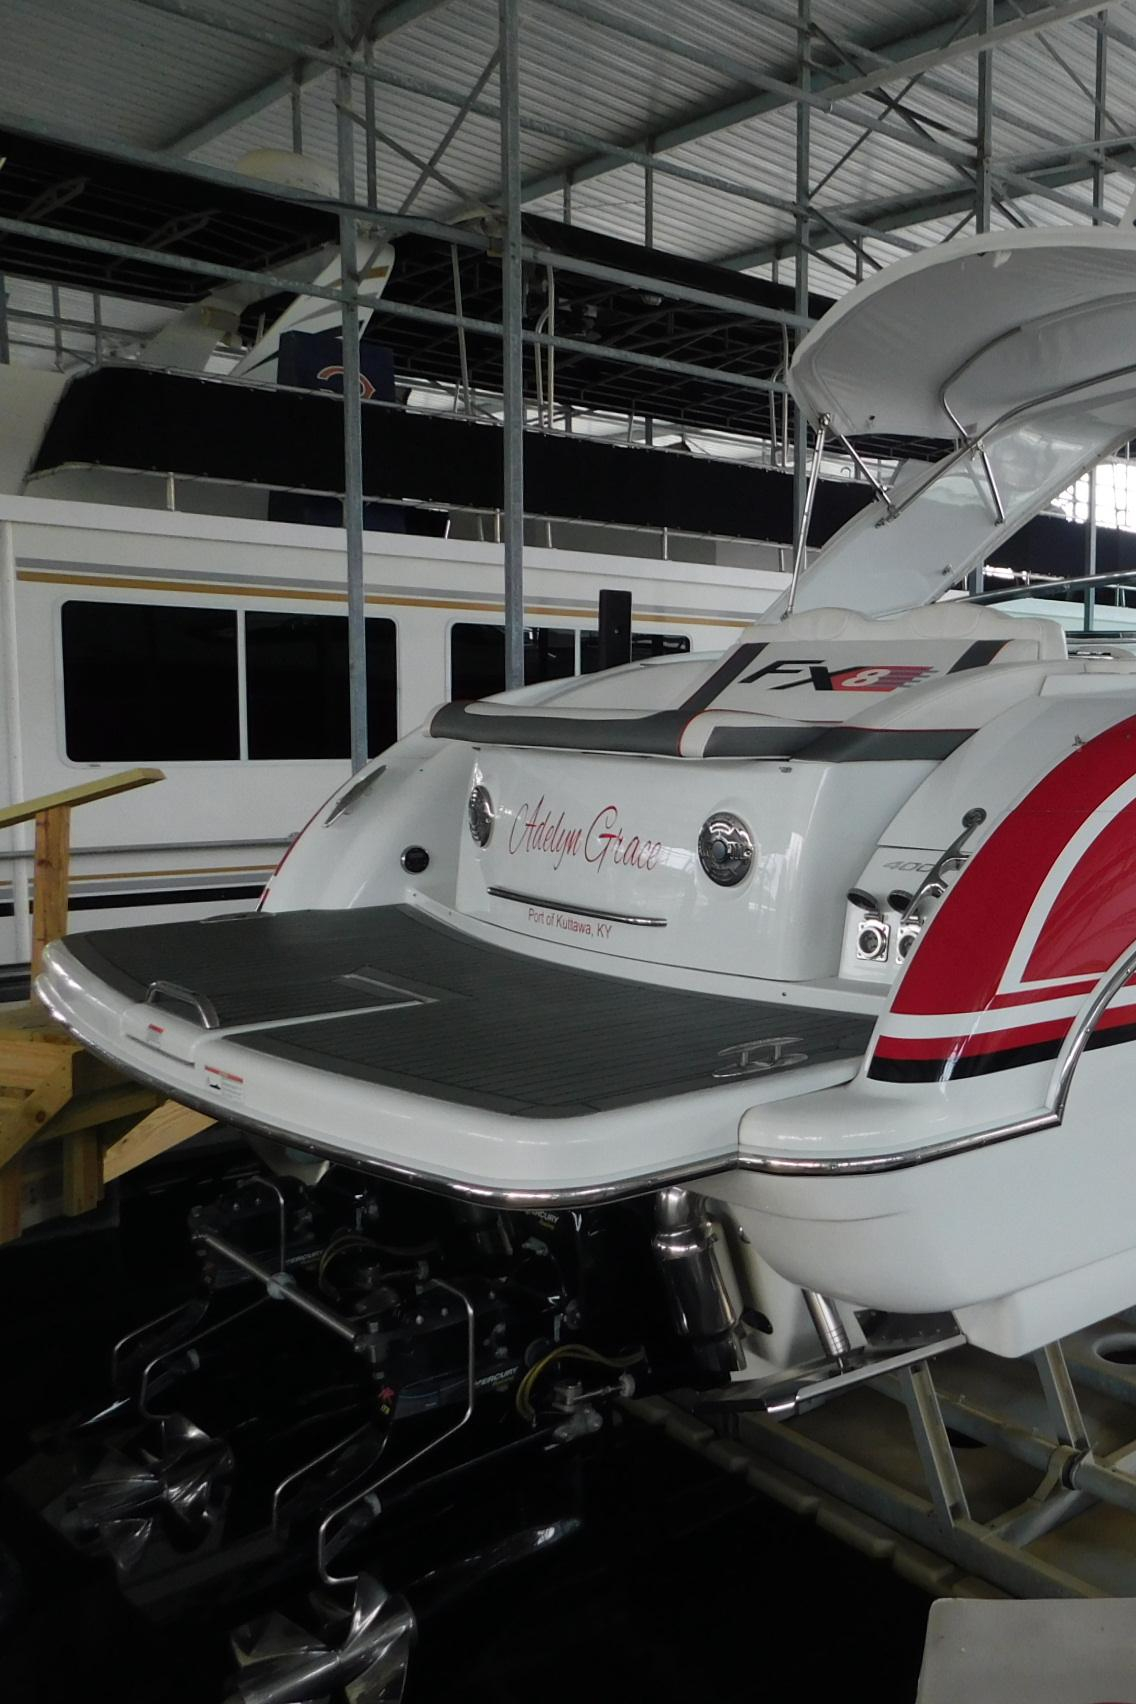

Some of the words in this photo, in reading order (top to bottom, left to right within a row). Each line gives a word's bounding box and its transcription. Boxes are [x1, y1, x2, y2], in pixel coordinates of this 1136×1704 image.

[585, 805, 662, 873] Grace
[528, 907, 545, 923] Port
[546, 912, 556, 926] of
[597, 923, 613, 939] KY
